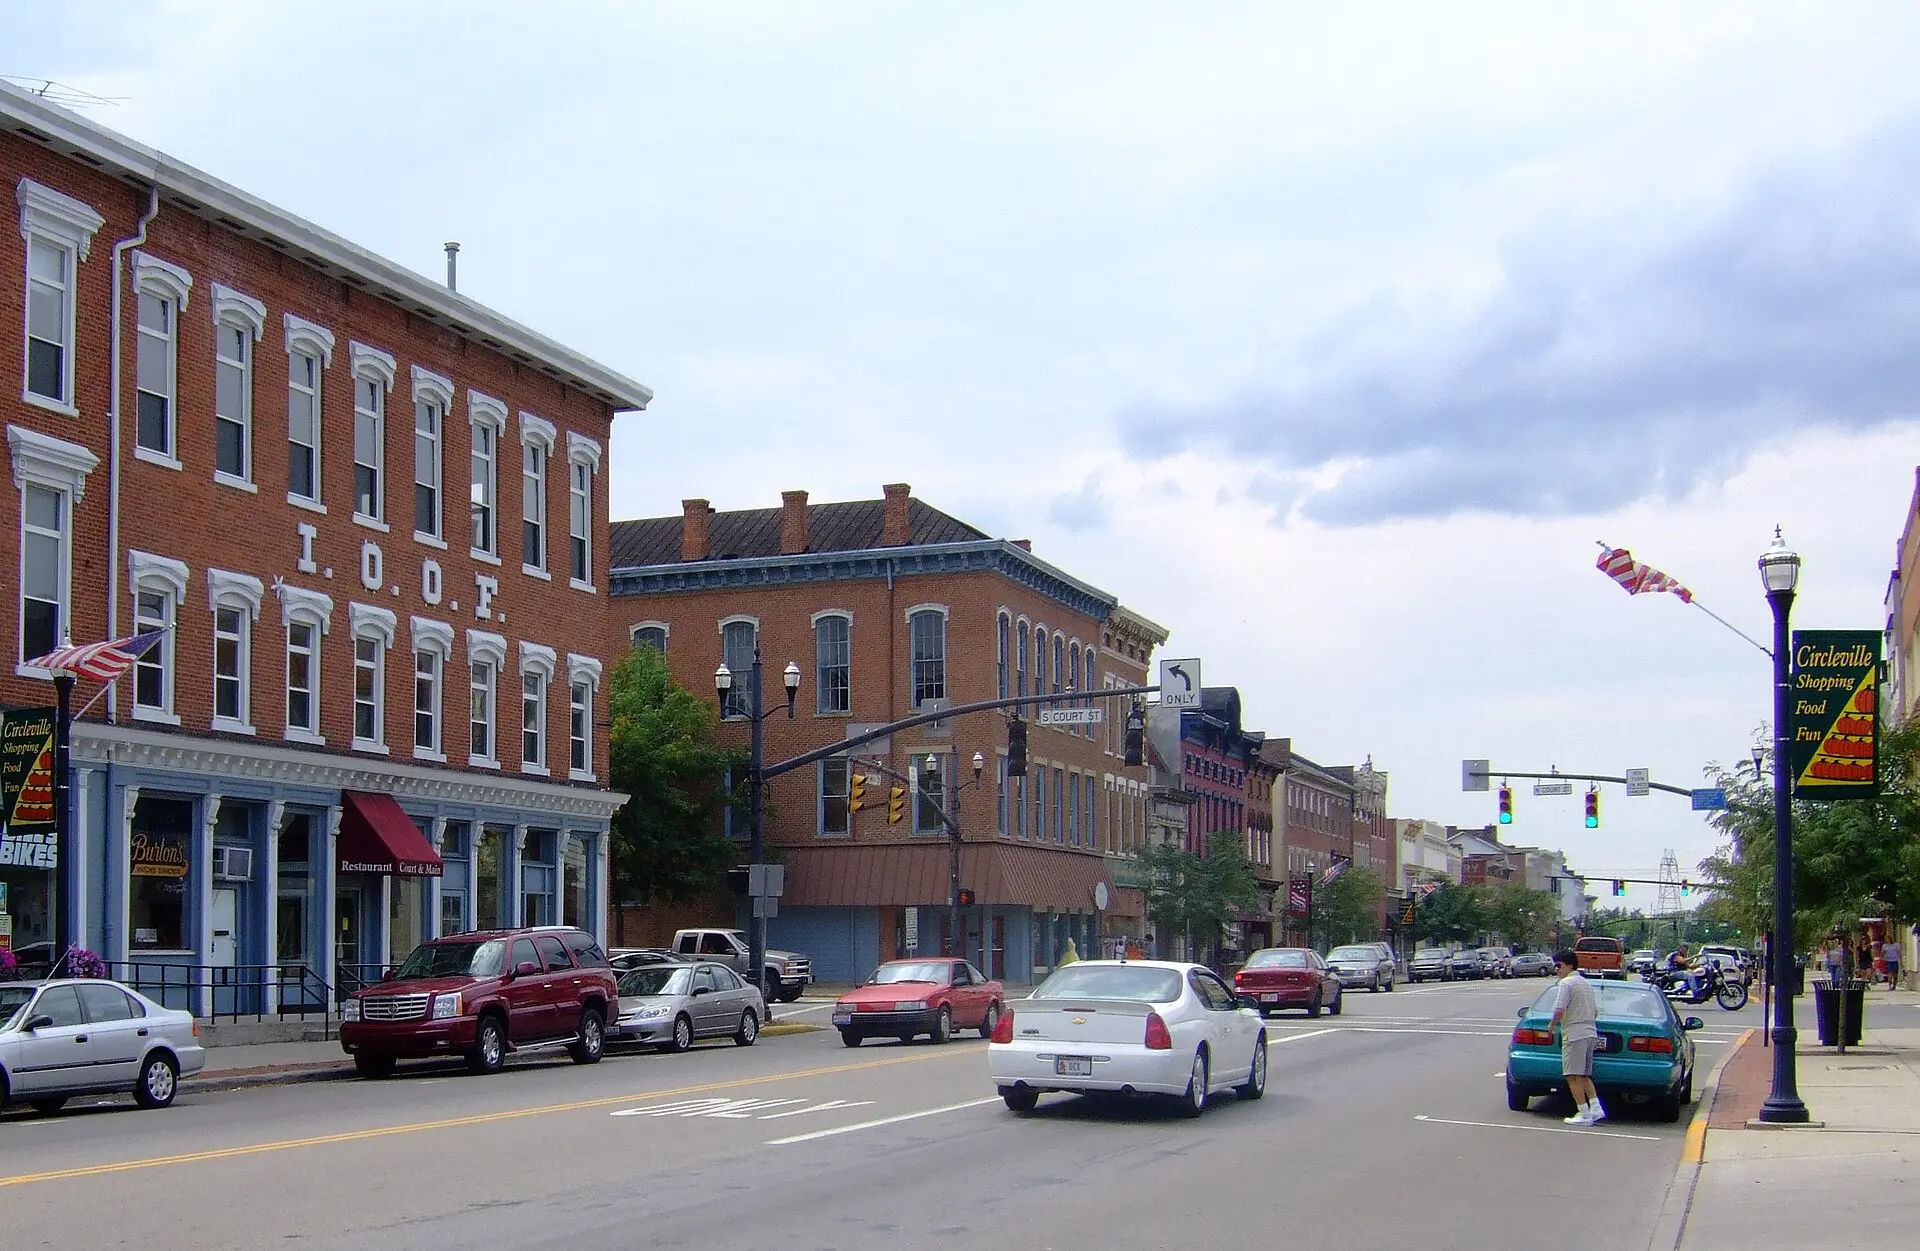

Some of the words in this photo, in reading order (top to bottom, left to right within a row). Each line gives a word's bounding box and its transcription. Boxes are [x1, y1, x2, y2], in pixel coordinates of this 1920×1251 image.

[1796, 645, 1873, 668] Circleville
[1796, 674, 1855, 692] Shopping
[1166, 693, 1196, 705] ONLY
[1795, 700, 1827, 715] Food
[1042, 712, 1049, 723] S
[1053, 710, 1084, 722] COURT
[1088, 709, 1100, 721] ST
[4, 718, 52, 738] Circleville
[1795, 727, 1822, 741] Fun
[3, 741, 40, 755] Shopping
[3, 761, 22, 773] Food
[4, 781, 20, 793] Fun
[0, 840, 58, 868] BIKES
[132, 833, 184, 863] Burton's
[341, 860, 393, 872] Restaurant
[399, 861, 417, 874] Court
[418, 864, 424, 874] &
[425, 863, 441, 875] Main
[609, 1098, 877, 1120] ONLY
